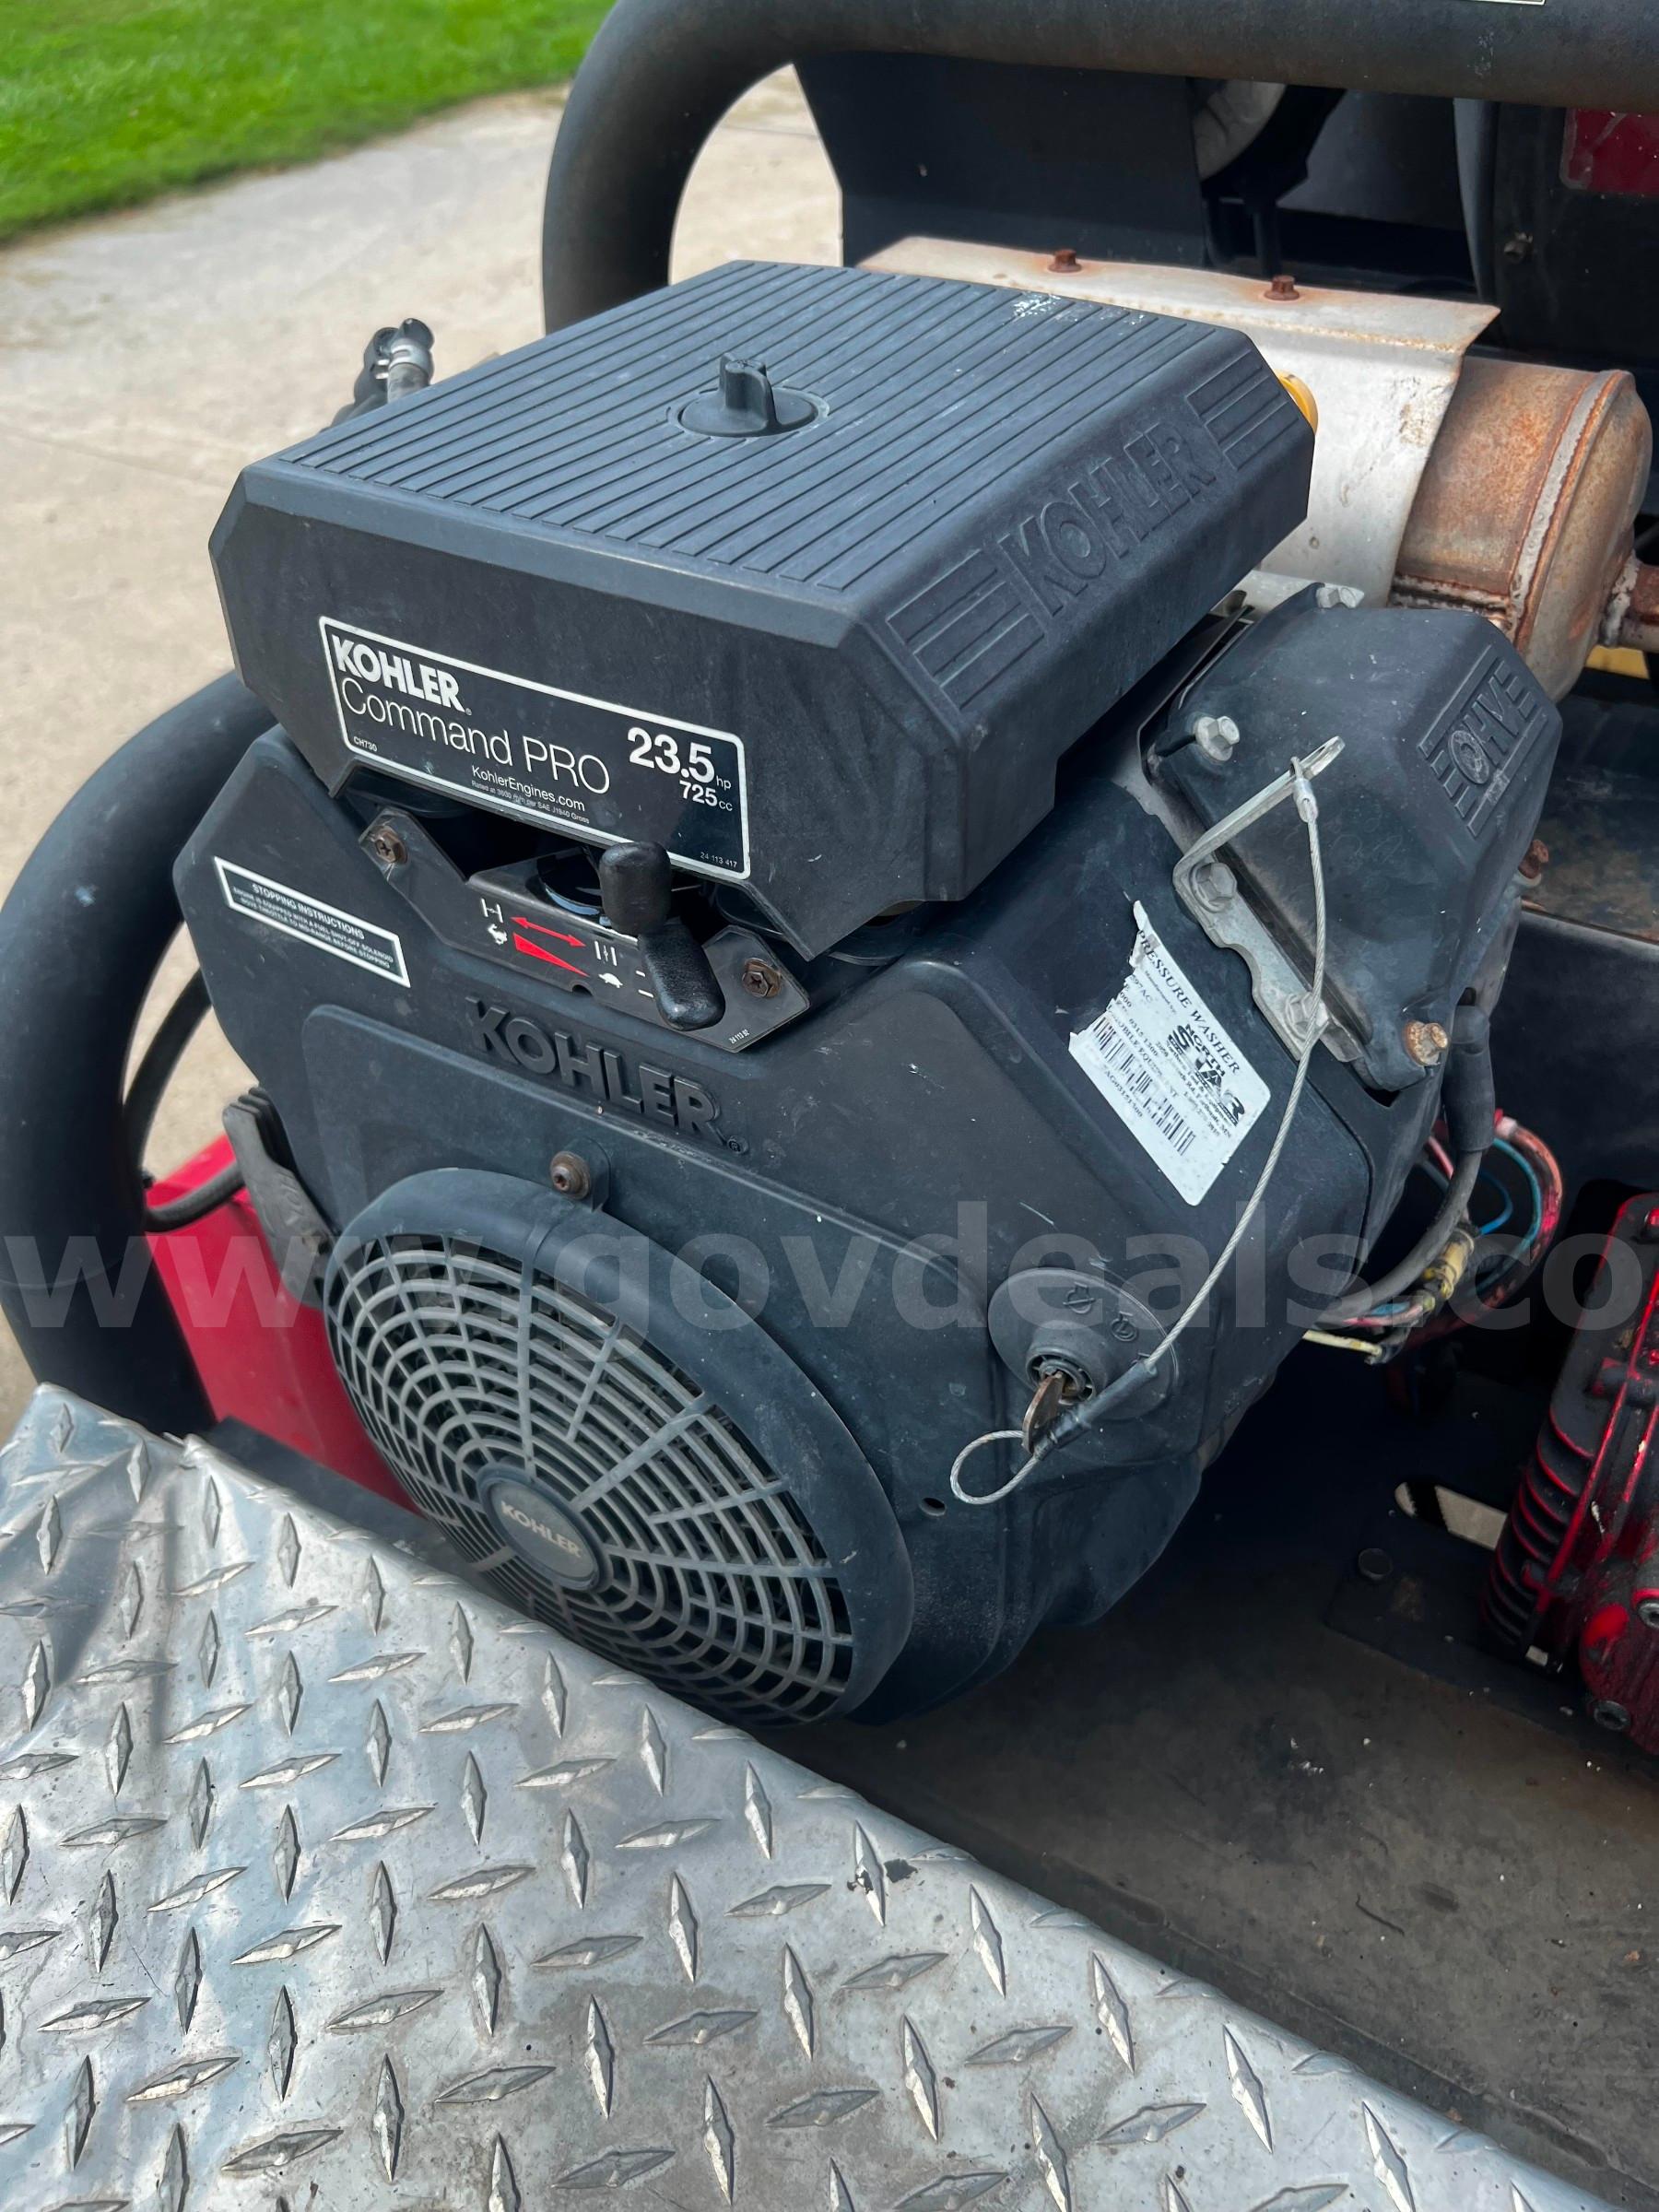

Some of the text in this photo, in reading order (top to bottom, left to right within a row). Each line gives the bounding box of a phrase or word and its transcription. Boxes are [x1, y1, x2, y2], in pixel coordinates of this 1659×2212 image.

[998, 418, 1217, 618] KOHLER
[331, 633, 465, 713] KOHLER
[340, 677, 610, 795] Command PRO
[353, 735, 378, 753] CH730
[627, 726, 733, 792] 23.5 hp
[471, 765, 586, 812] KohlerEngines.com
[679, 779, 734, 812] 725 cc
[700, 852, 737, 868] 24 113 417
[251, 882, 365, 940] STOPPING INSTRUCTIONS
[1138, 930, 1193, 1008] PRESSURE
[1192, 1009, 1241, 1074] WASHER
[465, 995, 728, 1147] KOHLER
[1171, 1024, 1246, 1123] STAR
[1184, 1021, 1226, 1079] NORTH
[501, 1500, 582, 1558] KOHLER
